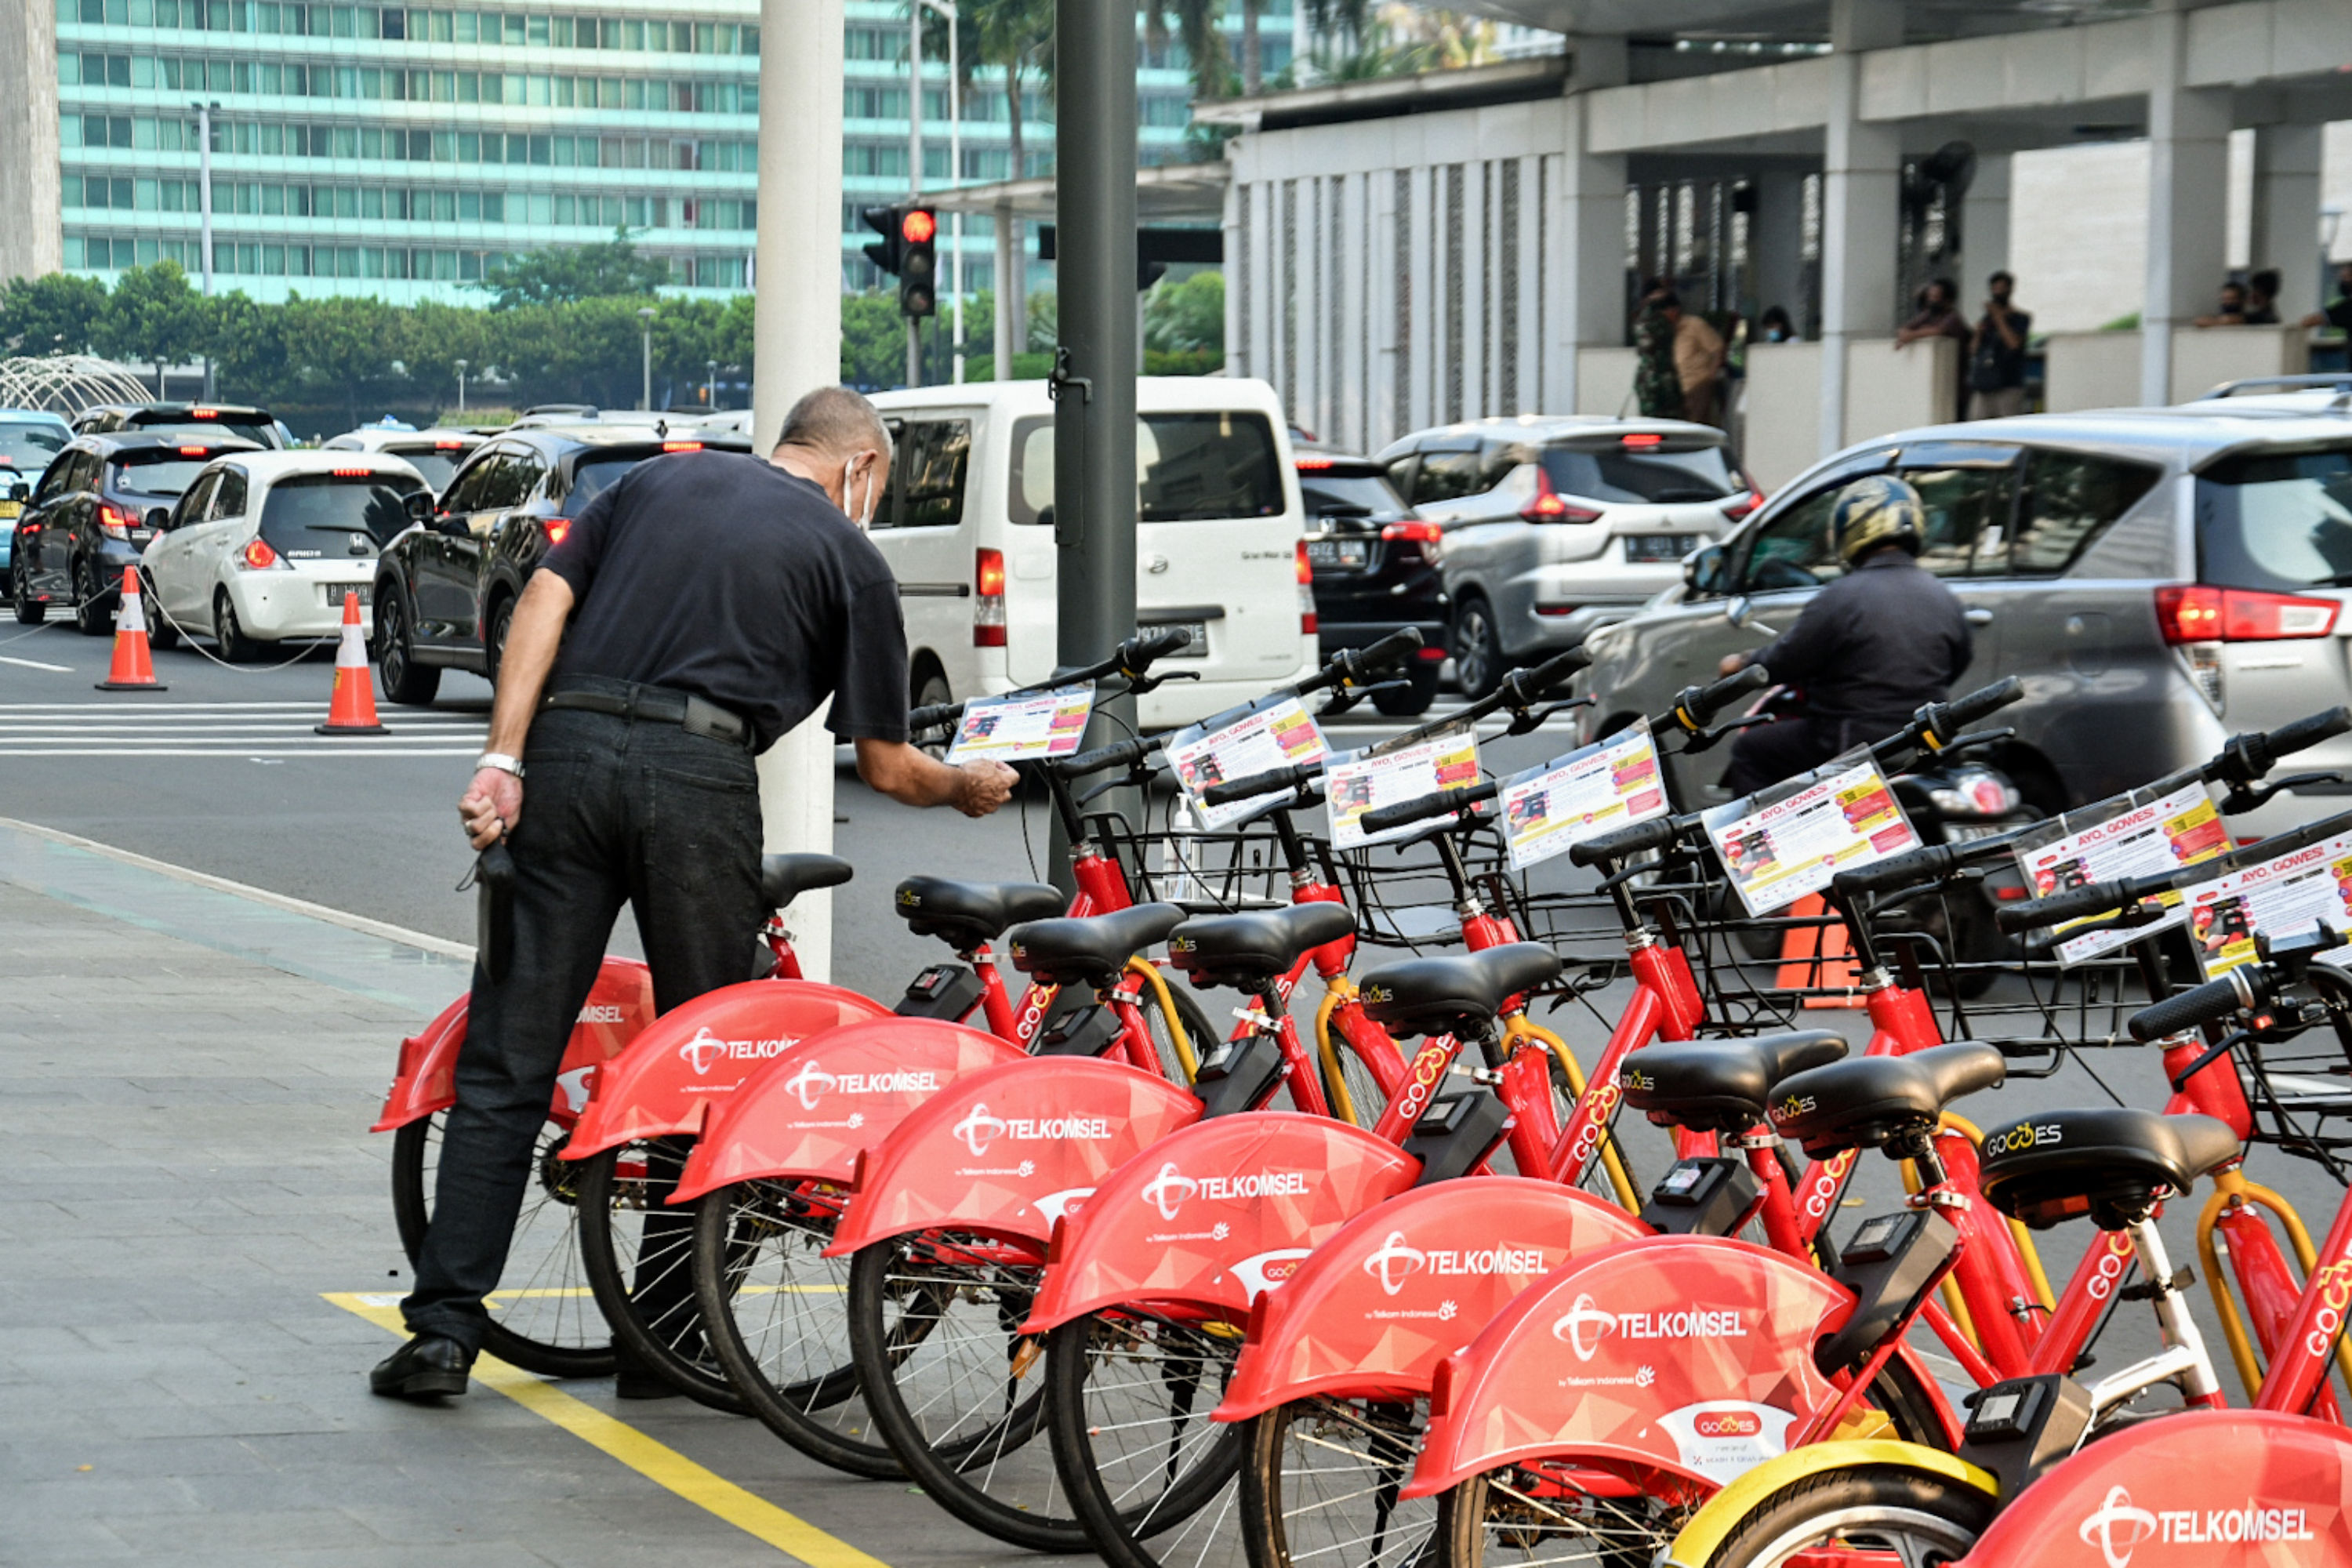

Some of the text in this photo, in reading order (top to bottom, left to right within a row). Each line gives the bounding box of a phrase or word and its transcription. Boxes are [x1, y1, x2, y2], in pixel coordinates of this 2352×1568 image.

[1760, 805, 1785, 821] AYO,
[2078, 829, 2106, 846] AYO,
[2107, 807, 2156, 833] GOWES!
[2241, 867, 2271, 884] AYO,
[837, 1073, 940, 1093] TELKOMSEL
[1006, 1119, 1112, 1139] TELKOMSEL
[1198, 1173, 1309, 1200] TELKOMSEL
[1426, 1250, 1548, 1275] TELKOMSEL
[1618, 1311, 1748, 1338] TELKOMSEL
[1566, 1376, 1595, 1385] Telkom
[2158, 1508, 2314, 1543] TELKOMSEL
